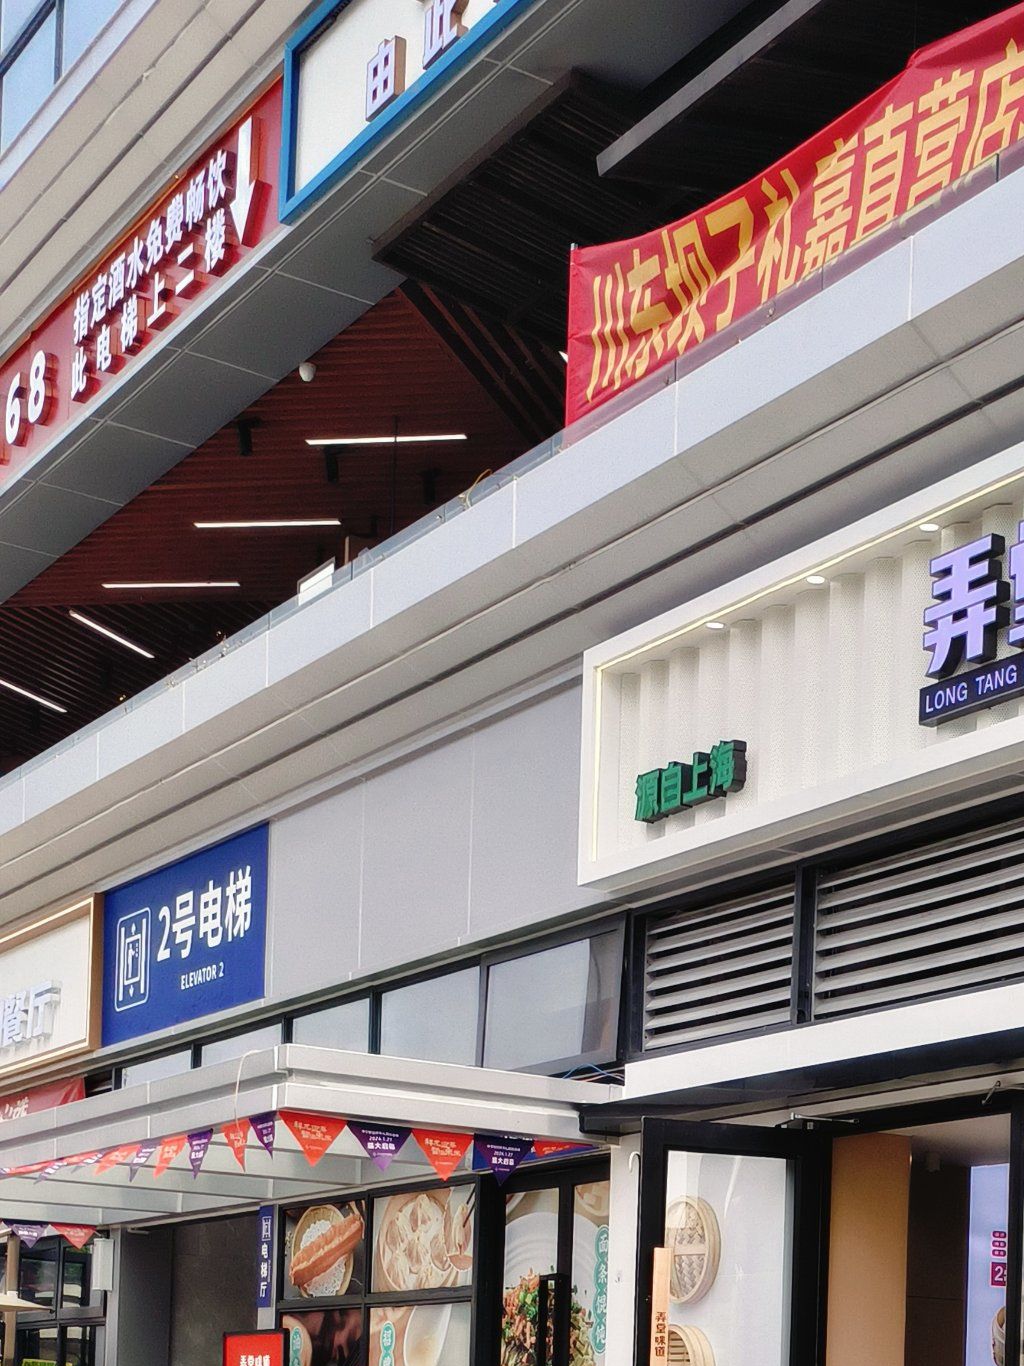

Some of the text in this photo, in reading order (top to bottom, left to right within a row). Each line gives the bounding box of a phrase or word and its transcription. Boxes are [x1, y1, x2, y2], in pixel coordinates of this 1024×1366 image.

[73, 148, 228, 347] 指定酒水免费畅饮
[71, 207, 227, 401] 此电梯上二楼
[925, 684, 968, 713] LONG
[975, 664, 1018, 696] TANG
[635, 740, 737, 821] 源自上海
[157, 865, 252, 962] 2号电梯
[180, 961, 225, 990] ELEVATOR 2
